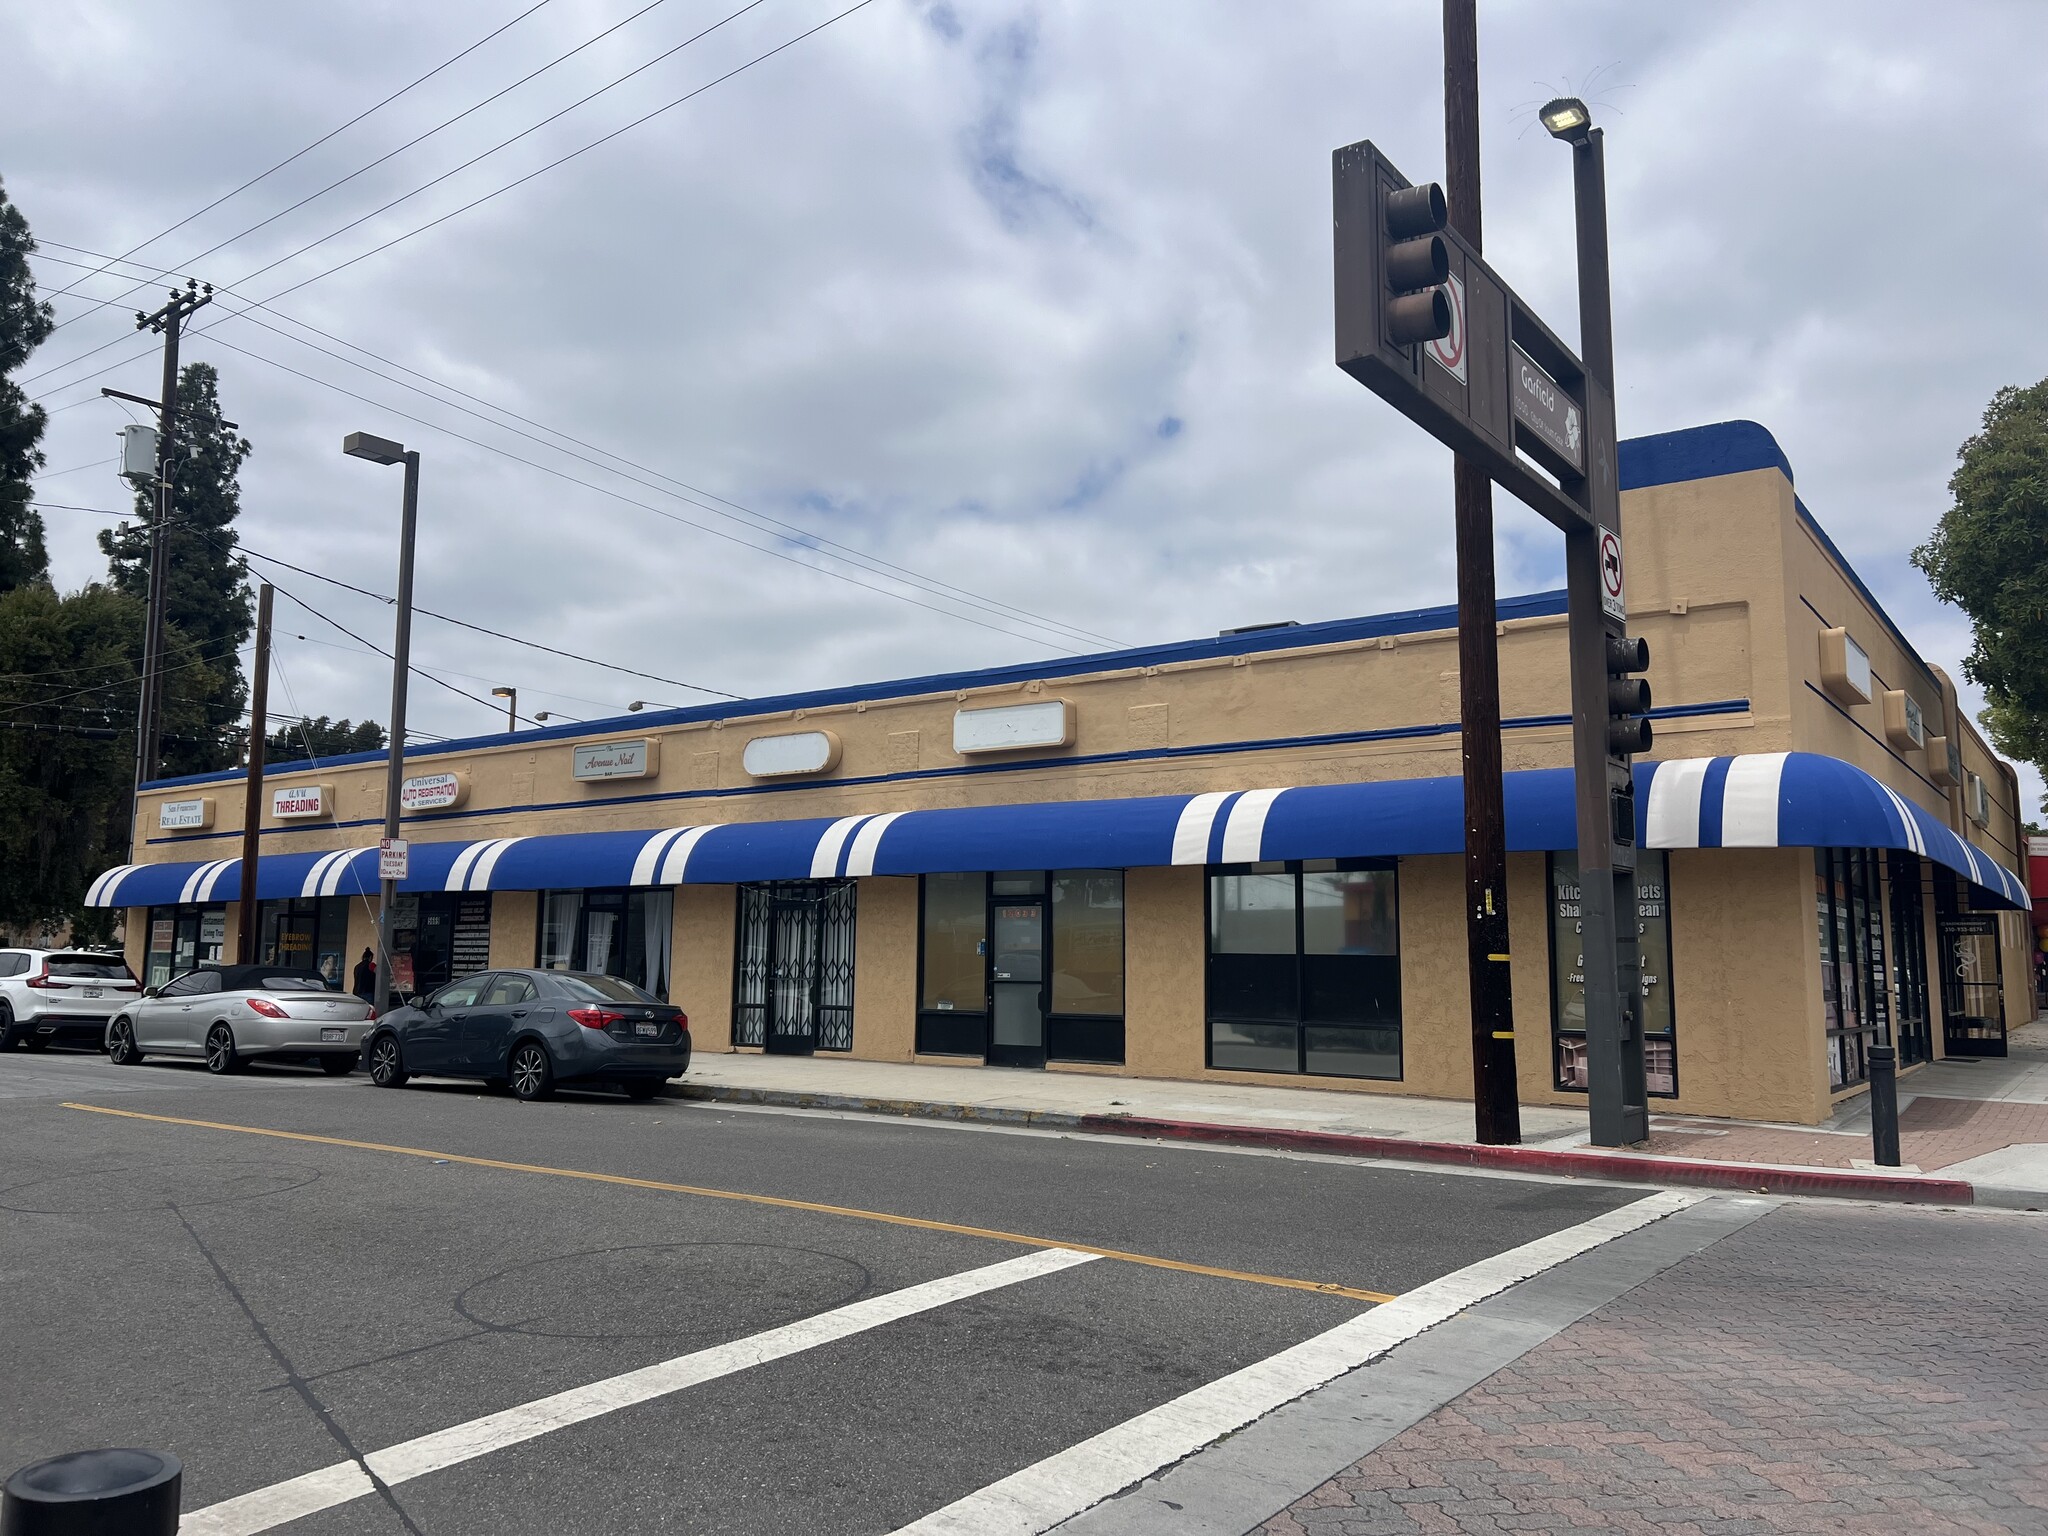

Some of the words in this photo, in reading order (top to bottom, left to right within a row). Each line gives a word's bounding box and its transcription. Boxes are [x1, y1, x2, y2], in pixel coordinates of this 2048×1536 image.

[1521, 365, 1554, 412] Garfield
[1612, 599, 1616, 612] 3
[585, 756, 613, 769] Avenue
[614, 752, 635, 767] Nail
[411, 774, 448, 787] Universal
[402, 788, 417, 802] AUTO
[418, 782, 457, 798] REGISTRATION
[276, 798, 319, 813] THREADING
[417, 796, 447, 806] SERVICES
[168, 804, 177, 813] San
[176, 803, 198, 812] Francisco
[161, 816, 178, 826] REAL
[178, 814, 202, 825] ESTATE
[381, 839, 390, 848] NO
[381, 851, 406, 859] PARKING
[1557, 885, 1580, 900] Kitc
[200, 915, 225, 925] Testament
[281, 932, 311, 942] EYEBROW
[1642, 973, 1657, 986] igns
